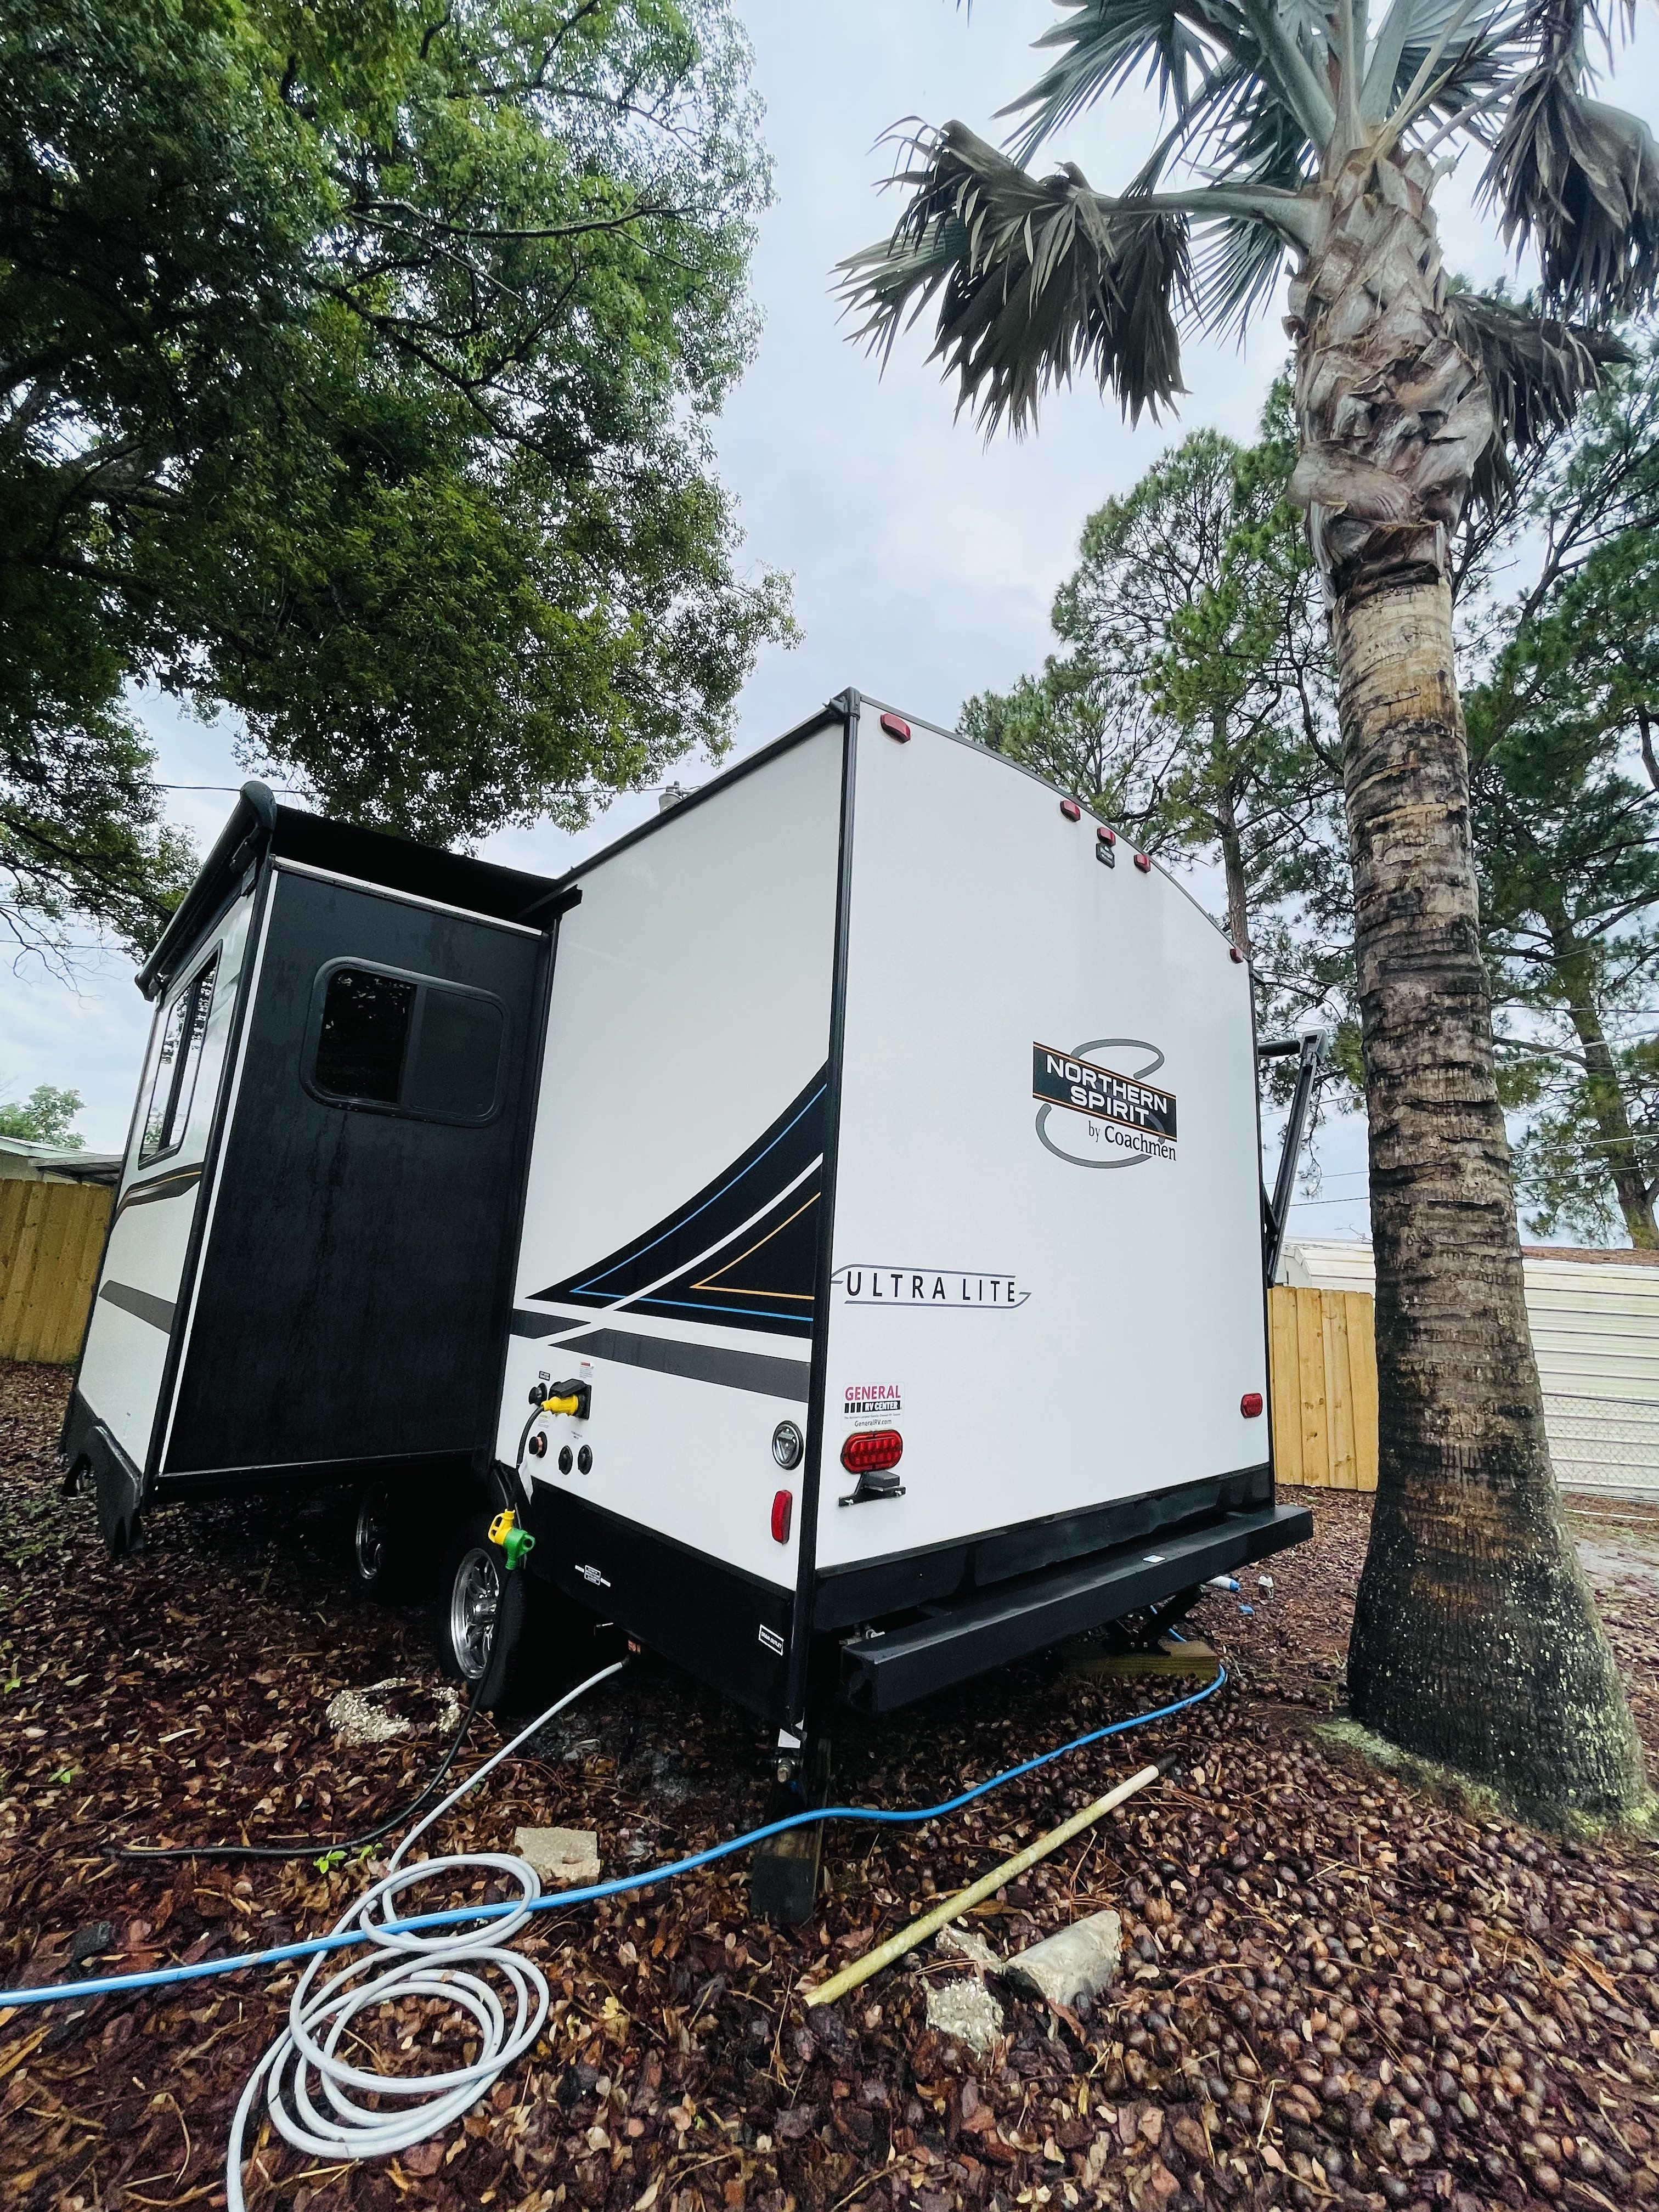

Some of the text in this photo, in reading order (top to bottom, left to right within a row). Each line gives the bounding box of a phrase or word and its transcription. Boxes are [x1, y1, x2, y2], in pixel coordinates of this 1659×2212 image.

[1047, 1054, 1167, 1114] NORTHERN
[1070, 1085, 1149, 1126] SPIRIT
[1088, 1120, 1177, 1161] by Coachmen
[847, 1271, 1015, 1302] ULTRA LITE
[845, 1385, 901, 1401] GENERAL
[865, 1401, 898, 1412] RV CENTER
